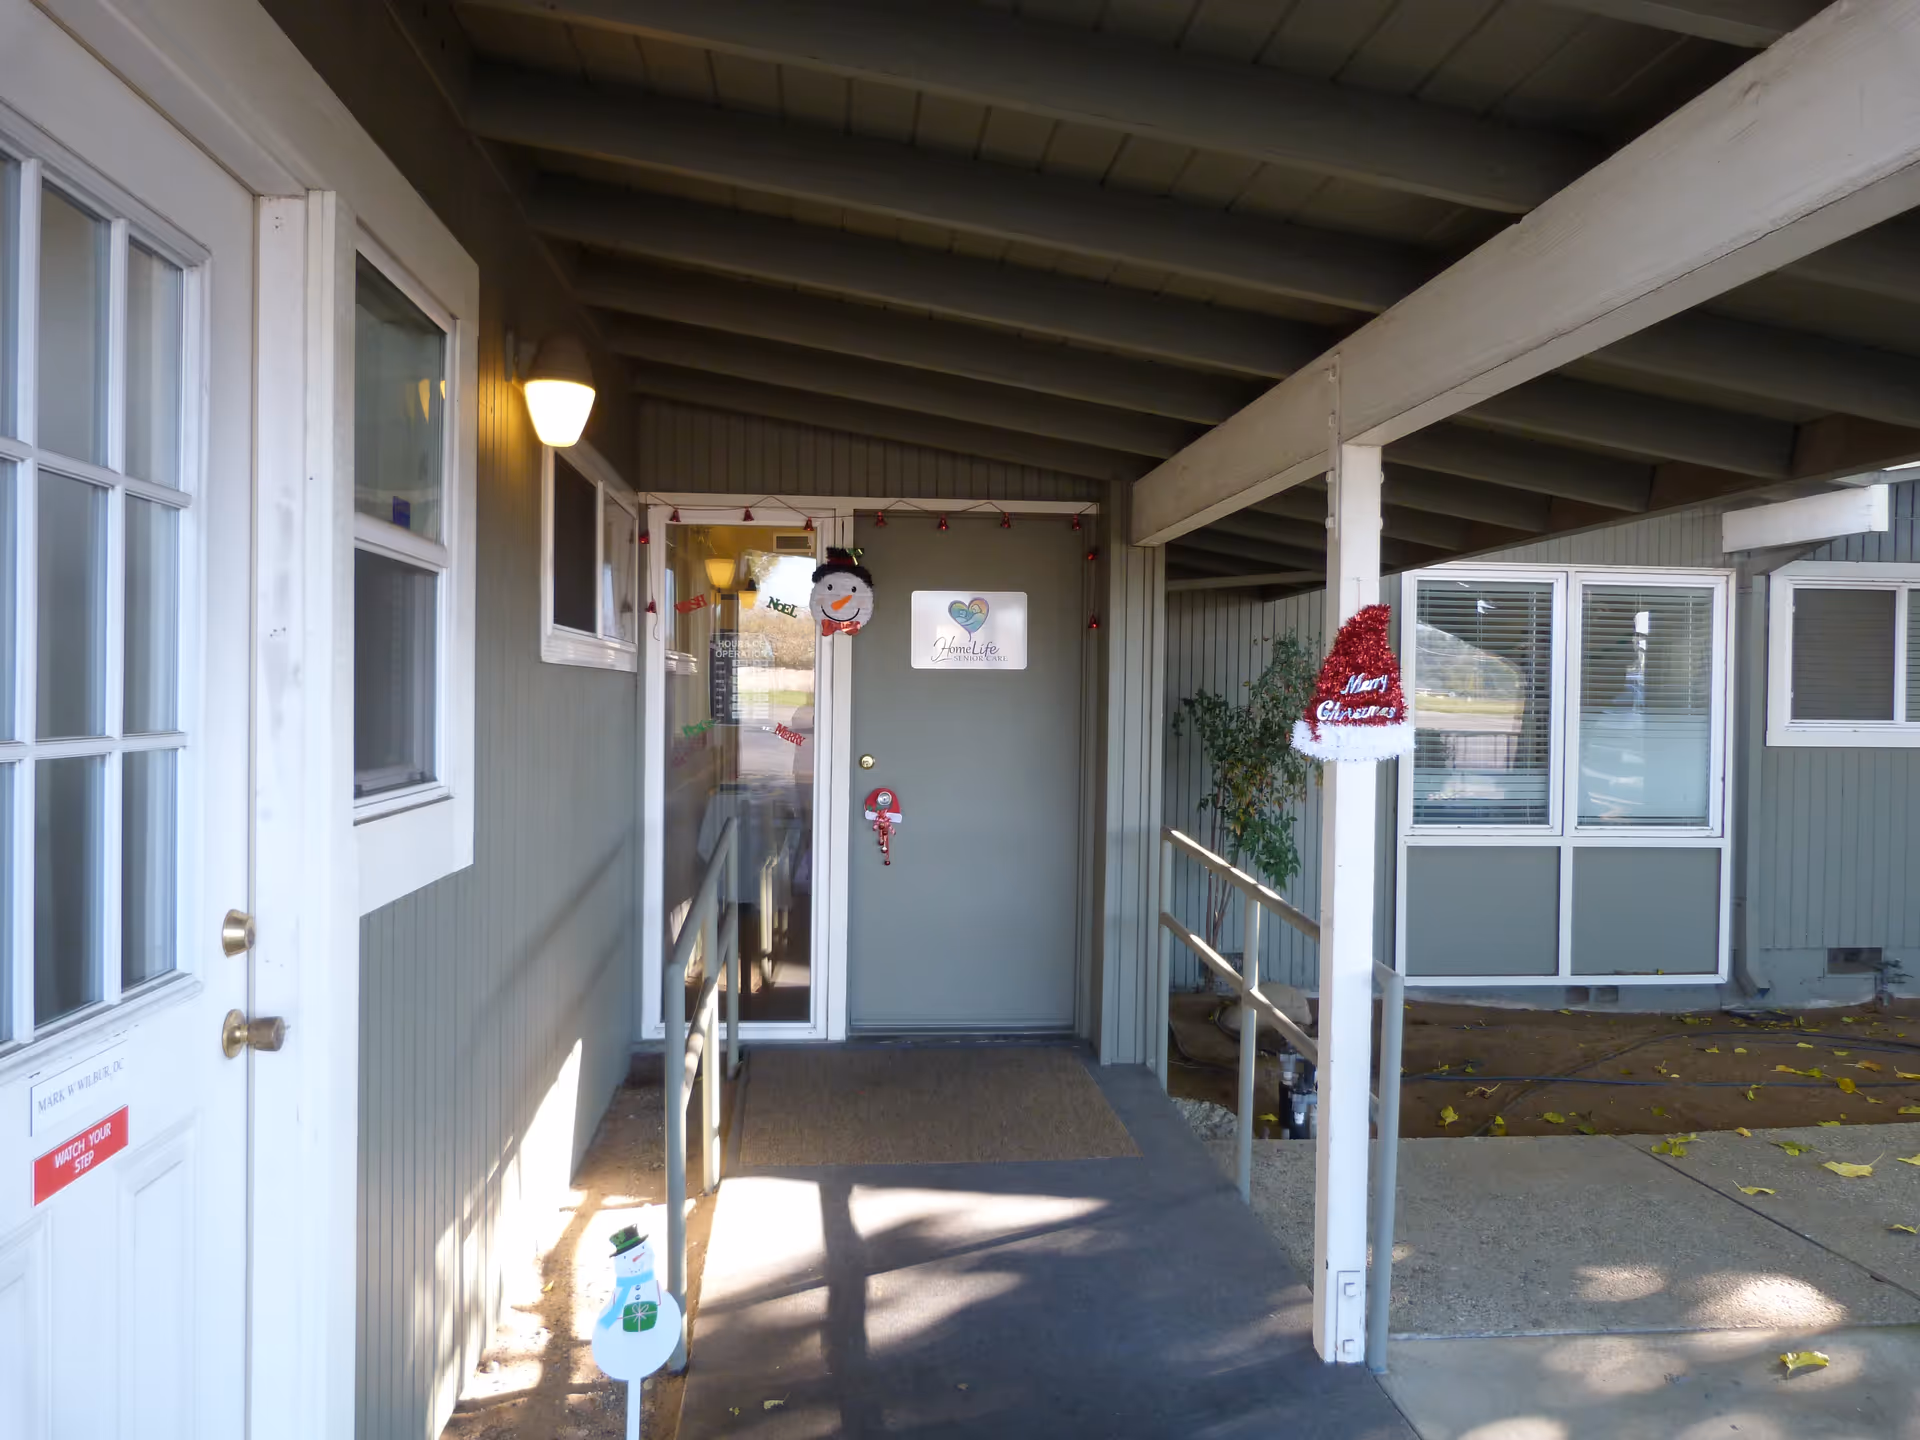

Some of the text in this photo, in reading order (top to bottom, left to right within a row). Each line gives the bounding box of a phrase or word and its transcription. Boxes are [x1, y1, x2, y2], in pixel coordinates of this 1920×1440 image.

[766, 596, 798, 618] NOEL
[718, 640, 750, 648] HOURS
[931, 636, 1000, 663] HomeLife
[1340, 673, 1389, 695] Merry
[1316, 700, 1397, 721] Christmas
[773, 723, 806, 746] MERRY
[37, 1088, 66, 1114] MARK
[54, 1122, 112, 1169] WATCH YOUR
[74, 1149, 95, 1173] STEP
